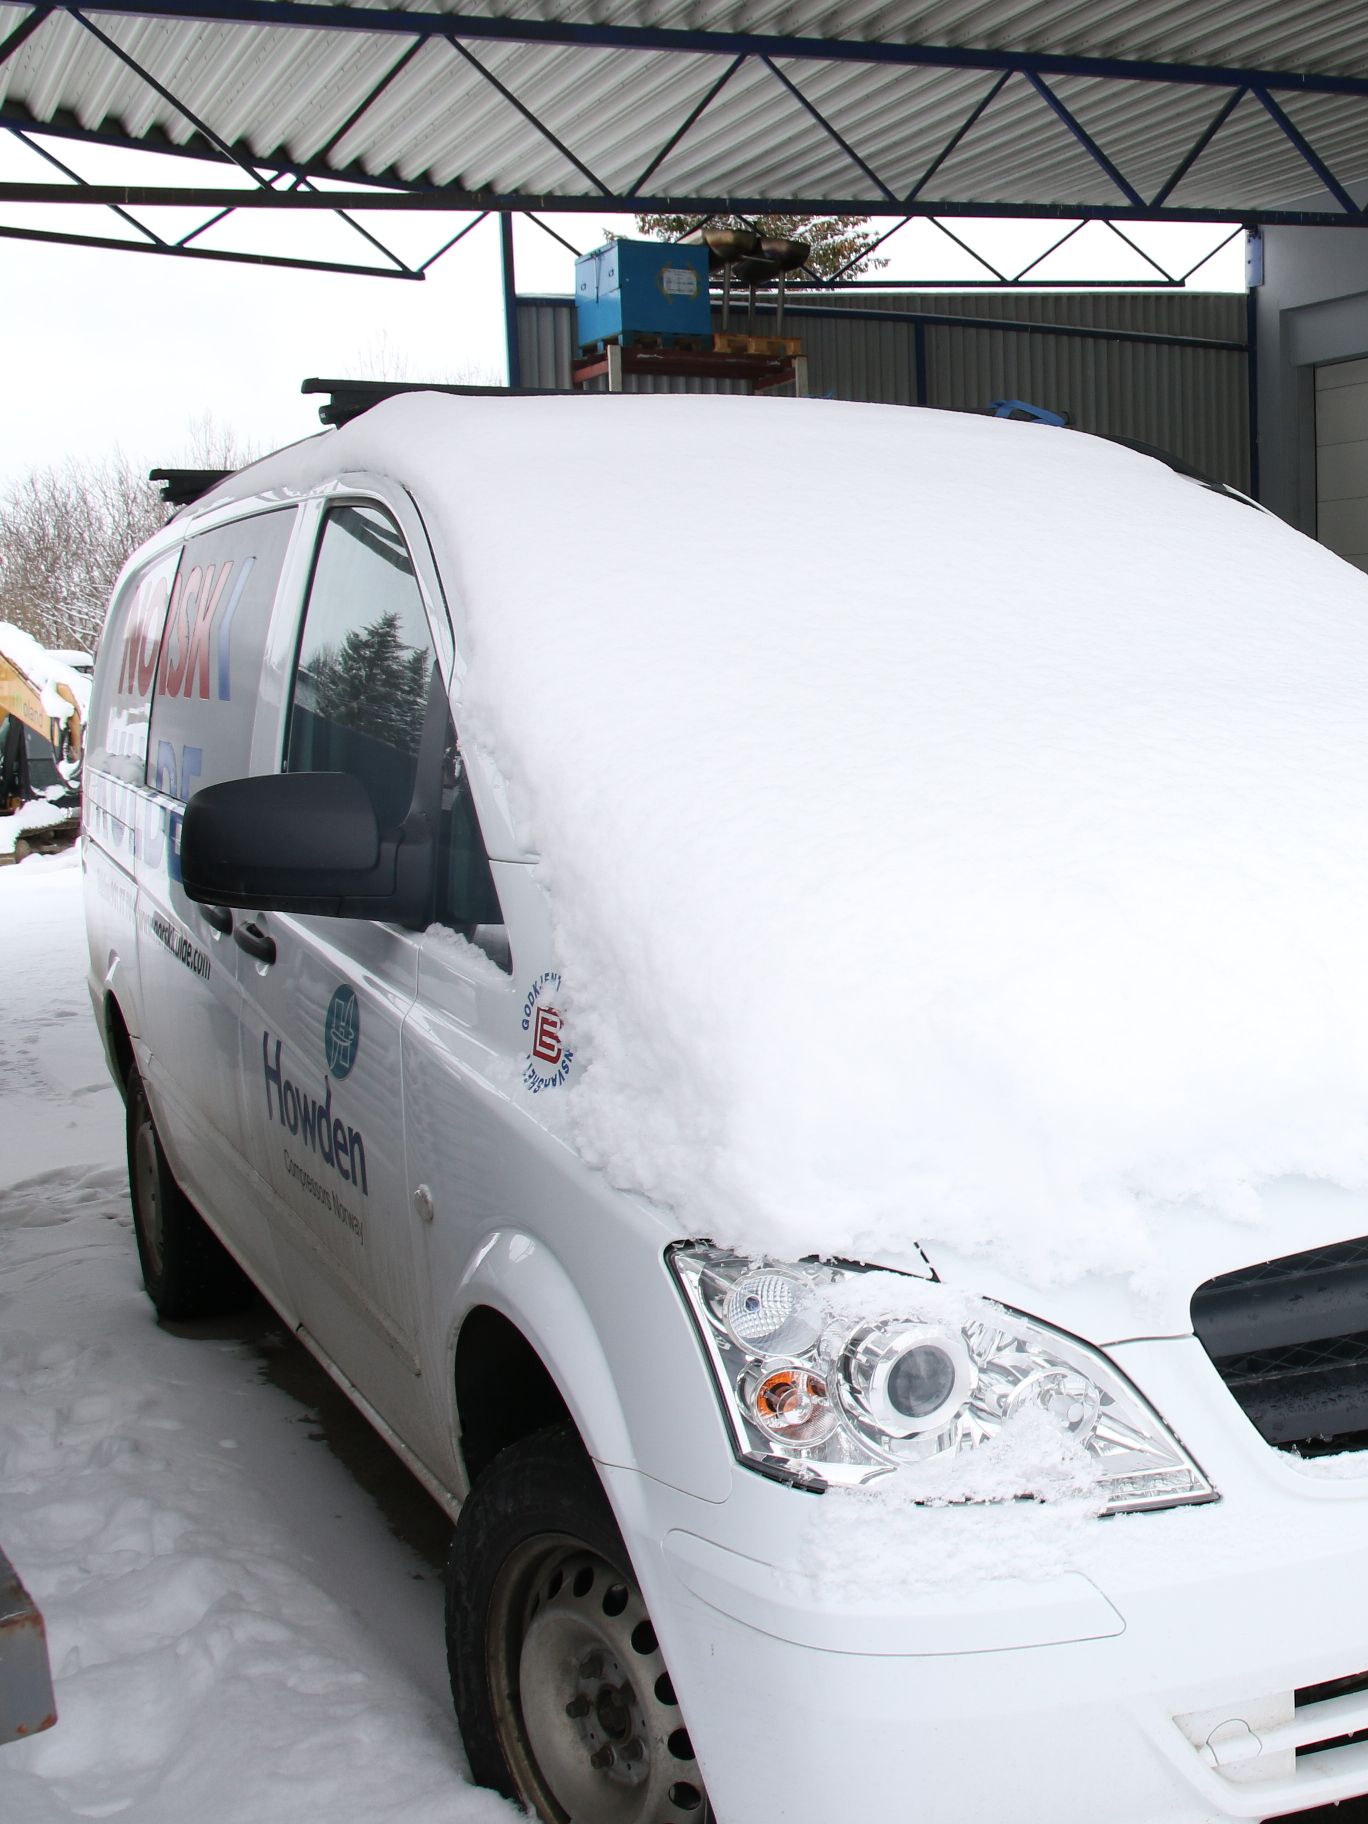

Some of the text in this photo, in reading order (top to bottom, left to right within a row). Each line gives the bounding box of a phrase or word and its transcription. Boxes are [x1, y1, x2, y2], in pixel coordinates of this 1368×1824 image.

[263, 1030, 368, 1196] Howden
[284, 1148, 364, 1246] Compressors Norway
